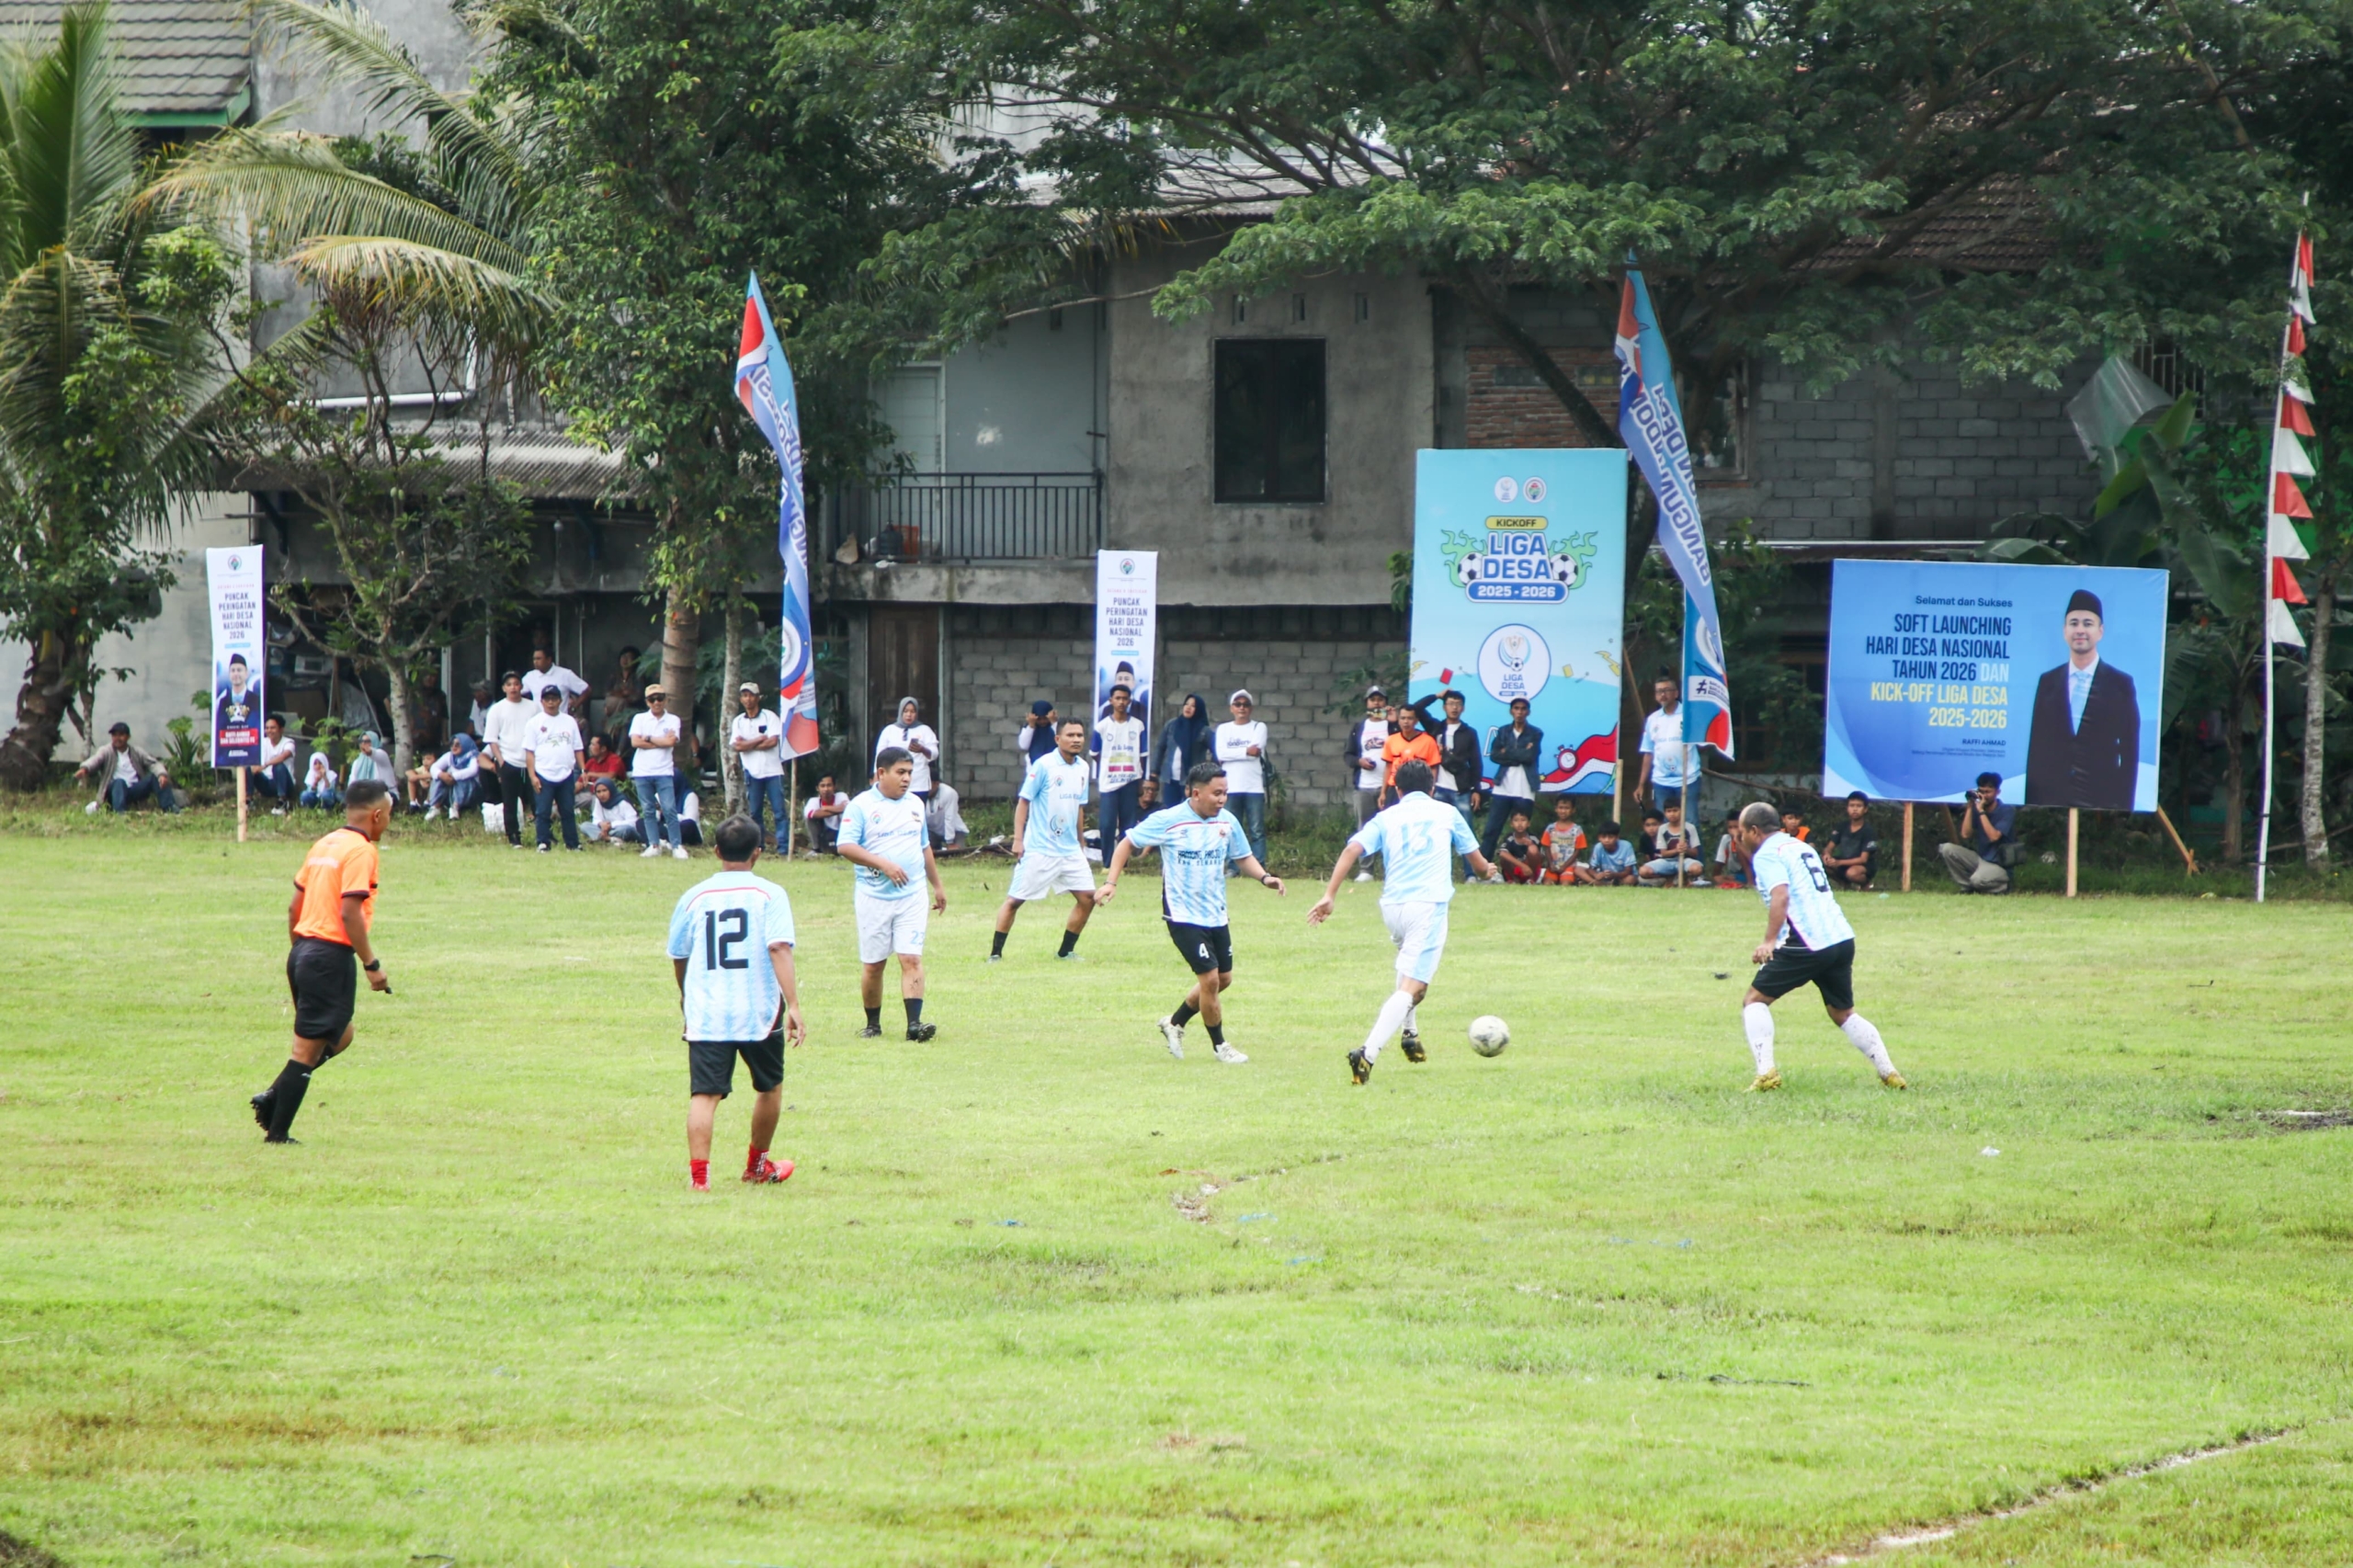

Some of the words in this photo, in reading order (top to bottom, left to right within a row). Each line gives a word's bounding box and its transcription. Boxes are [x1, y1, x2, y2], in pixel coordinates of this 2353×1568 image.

[1496, 518, 1537, 528] KICKOFF
[1490, 534, 1546, 555] LIGA
[1483, 558, 1552, 579] DESA
[224, 592, 248, 600] PUNCAK
[1478, 585, 1512, 597] 2025
[1521, 586, 1556, 597] 2026
[219, 602, 256, 611] PERINGATAN
[1113, 597, 1141, 606] PUNCAK
[1915, 596, 1955, 606] Selamat
[1958, 597, 1975, 606] dan
[1978, 597, 2013, 608] Sukses
[236, 611, 254, 619] DESA
[1106, 608, 1148, 617] PERINGATAN
[223, 621, 252, 630] NASIONAL
[1108, 618, 1124, 626] HARI
[1127, 618, 1144, 626] DESA
[1894, 613, 1928, 633] SOFT
[1933, 615, 2012, 636] LAUNCHING
[229, 631, 244, 640] 2026
[1109, 628, 1142, 636] NASIONAL
[1117, 638, 1134, 646] 2026
[1866, 636, 1898, 654] HARI
[1902, 637, 1937, 656] DESA
[1941, 639, 2010, 659] NASIONAL
[1893, 660, 1937, 679] TAHUN
[1940, 661, 1976, 681] 2026
[1980, 663, 2009, 682] DAN
[1870, 681, 1935, 702] KICK-OFF
[1938, 684, 1968, 704] LIGA
[1972, 686, 2008, 706] DESA
[1928, 707, 2007, 729] 2025-2026
[1401, 820, 1434, 858] 13
[1801, 852, 1828, 892] 6
[704, 907, 749, 971] 12
[1199, 942, 1210, 959] 4
